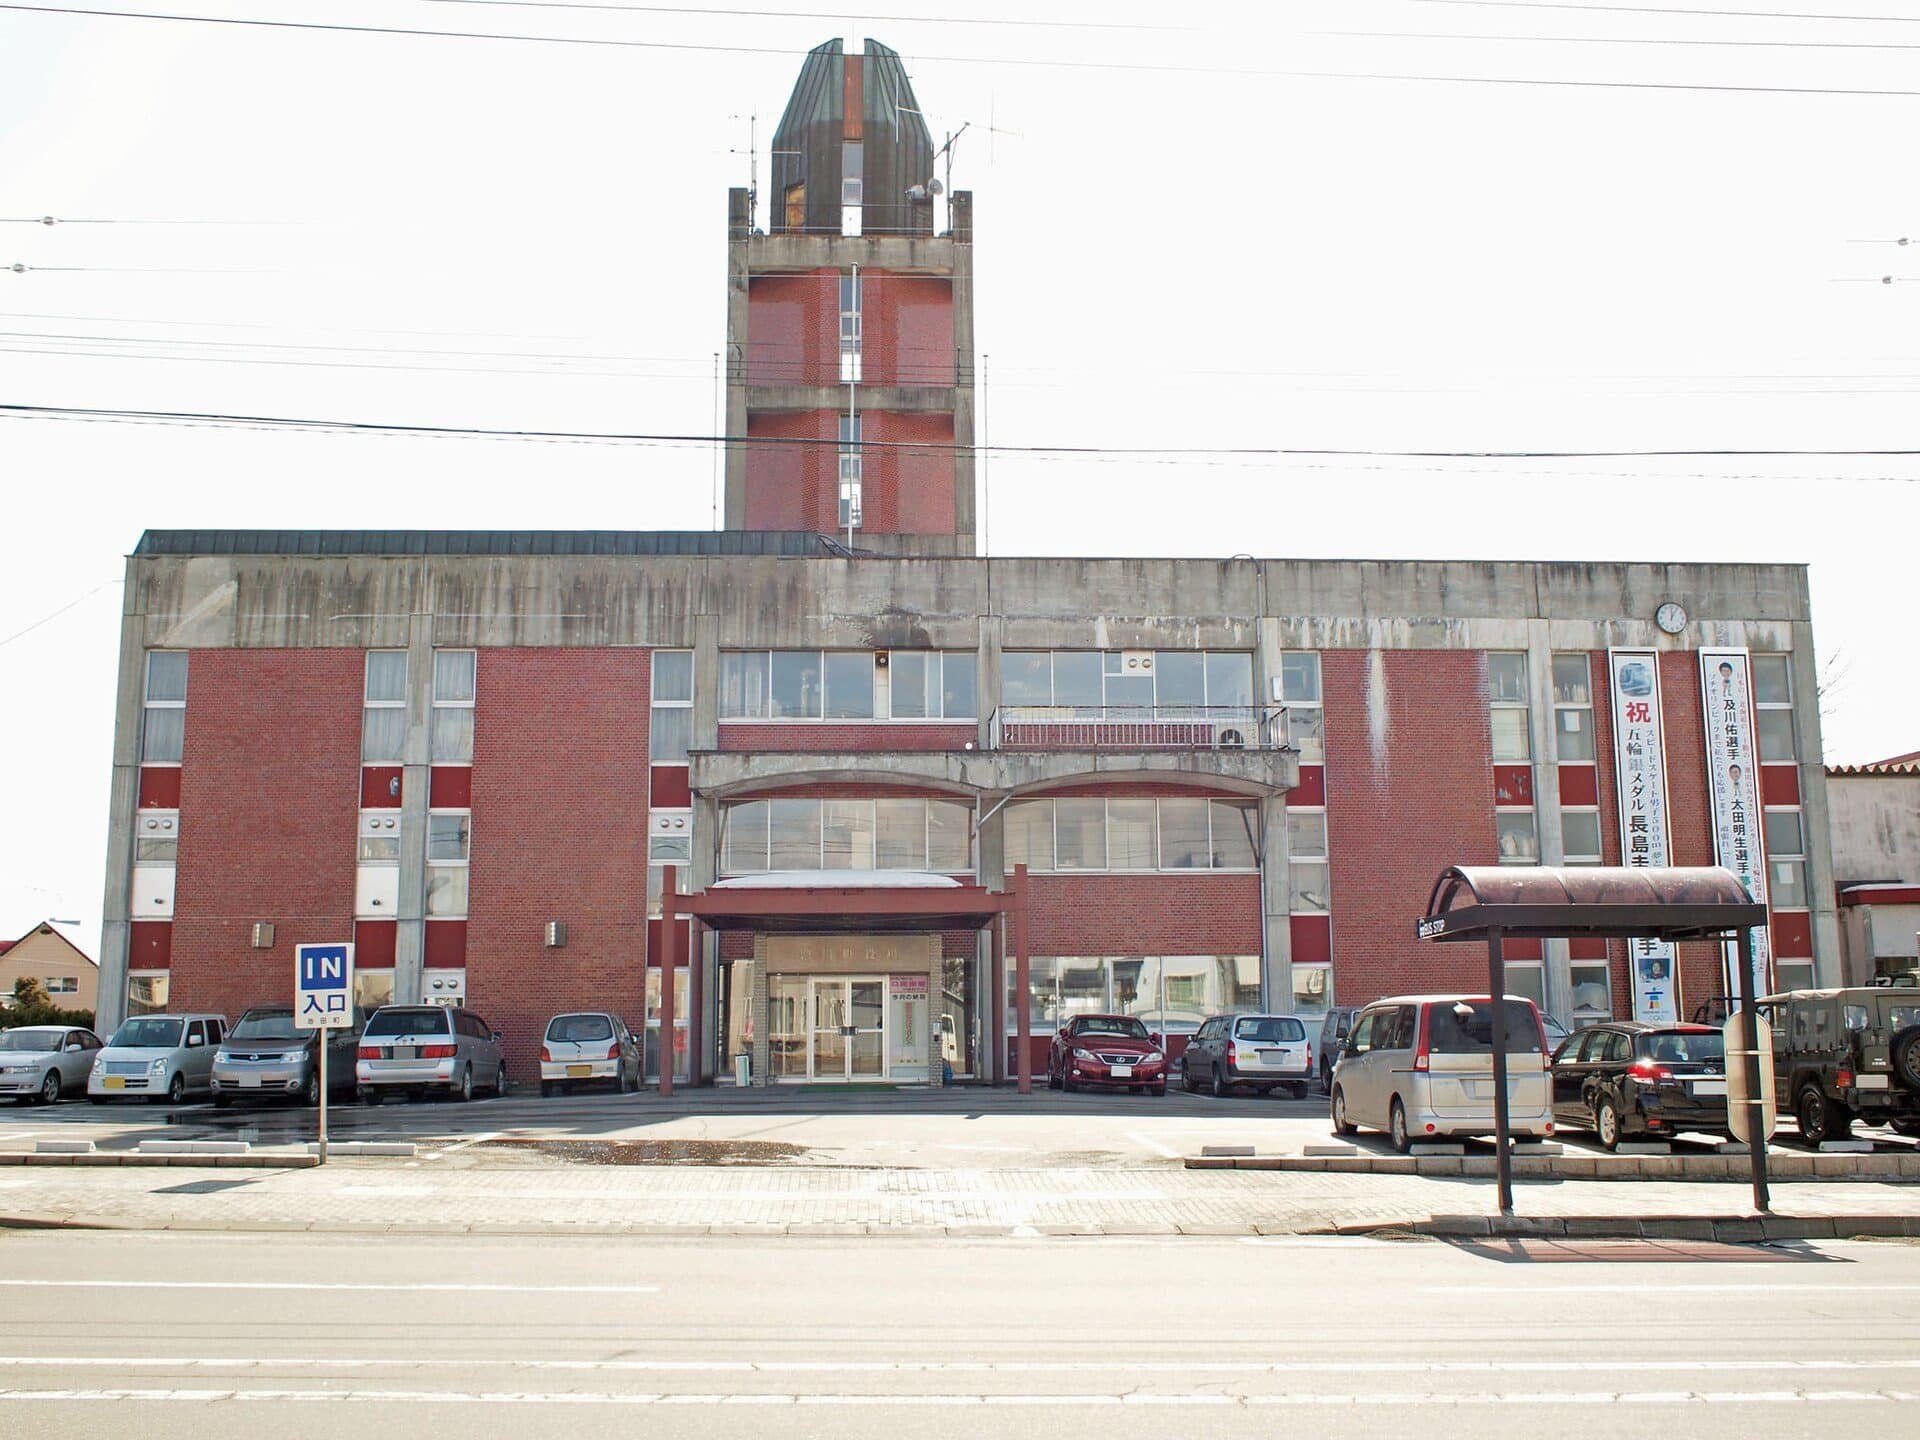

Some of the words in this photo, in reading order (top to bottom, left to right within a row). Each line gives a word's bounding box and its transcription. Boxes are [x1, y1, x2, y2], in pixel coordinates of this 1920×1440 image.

[1626, 701, 1651, 723] 祝
[1723, 699, 1740, 760] 及川佑選手
[1731, 799, 1750, 874] 太田明生選手
[1432, 919, 1445, 933] STOP
[307, 957, 341, 979] IN
[303, 994, 345, 1014] 入口
